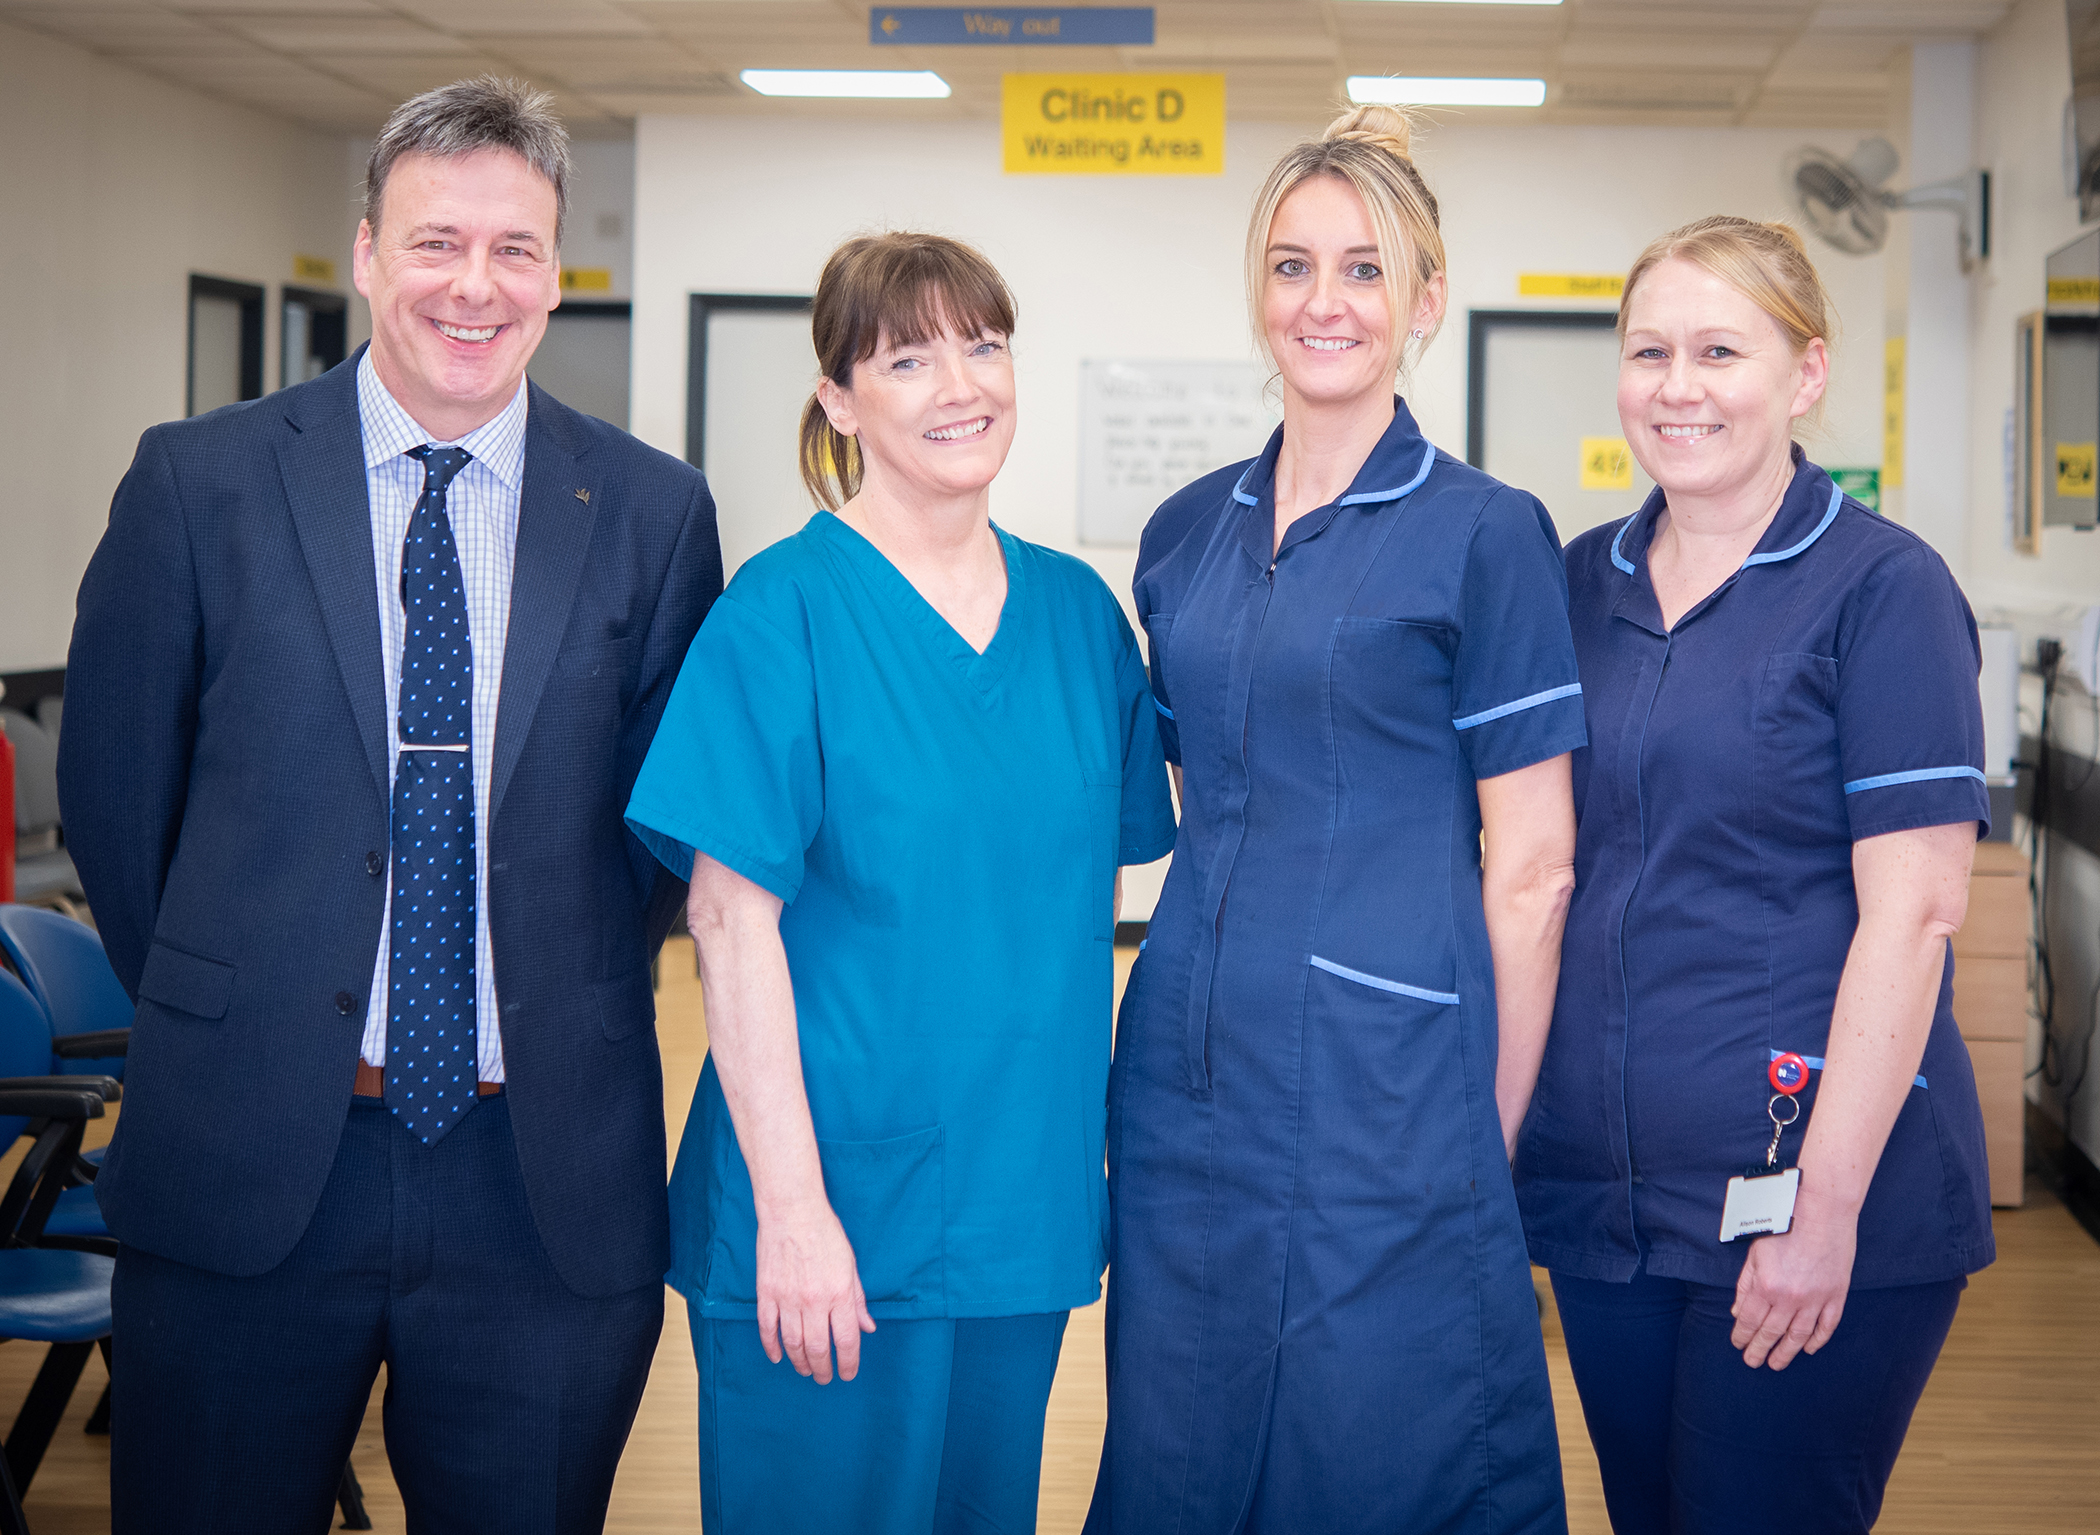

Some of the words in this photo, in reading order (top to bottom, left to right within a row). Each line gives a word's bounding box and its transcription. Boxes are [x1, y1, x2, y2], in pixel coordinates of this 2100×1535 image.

[963, 13, 1014, 41] Way
[1022, 16, 1060, 36] out
[1041, 87, 1147, 123] Clinic
[1156, 88, 1185, 123] D
[1023, 134, 1131, 167] Waiting
[1138, 134, 1204, 161] Area
